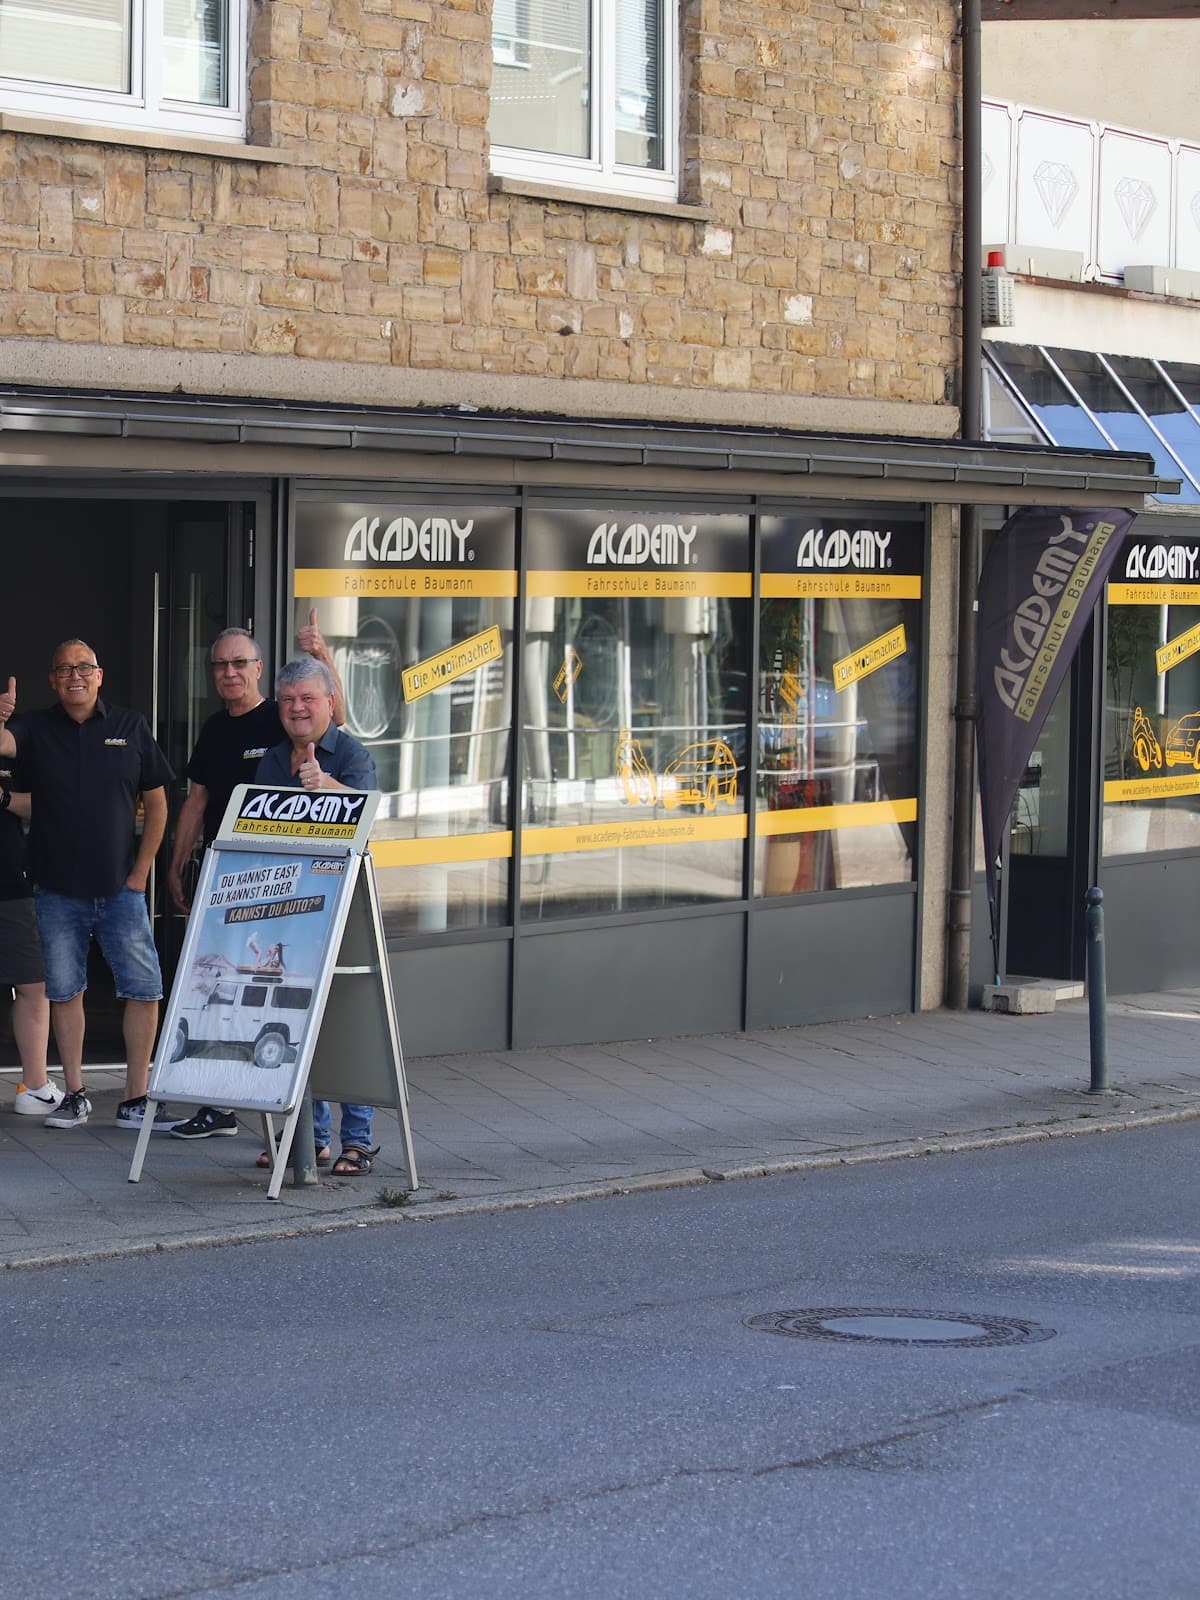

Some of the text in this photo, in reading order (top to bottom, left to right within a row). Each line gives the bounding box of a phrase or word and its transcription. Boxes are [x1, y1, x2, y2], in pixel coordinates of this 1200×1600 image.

[344, 576, 473, 591] Fahrschule Baumann
[587, 577, 697, 591] Fahrschule Baumann
[797, 580, 891, 593] Fahrschule Baumann
[1126, 588, 1199, 600] Fahrschule Baumann
[1018, 525, 1112, 718] Fahrschule Baumann
[235, 820, 354, 837] Fahrschule Baumann
[221, 864, 299, 889] DU KANNST EASY.
[210, 881, 293, 906] DU KANNST RIDER.
[228, 905, 266, 923] KANNST
[268, 903, 283, 917] DU
